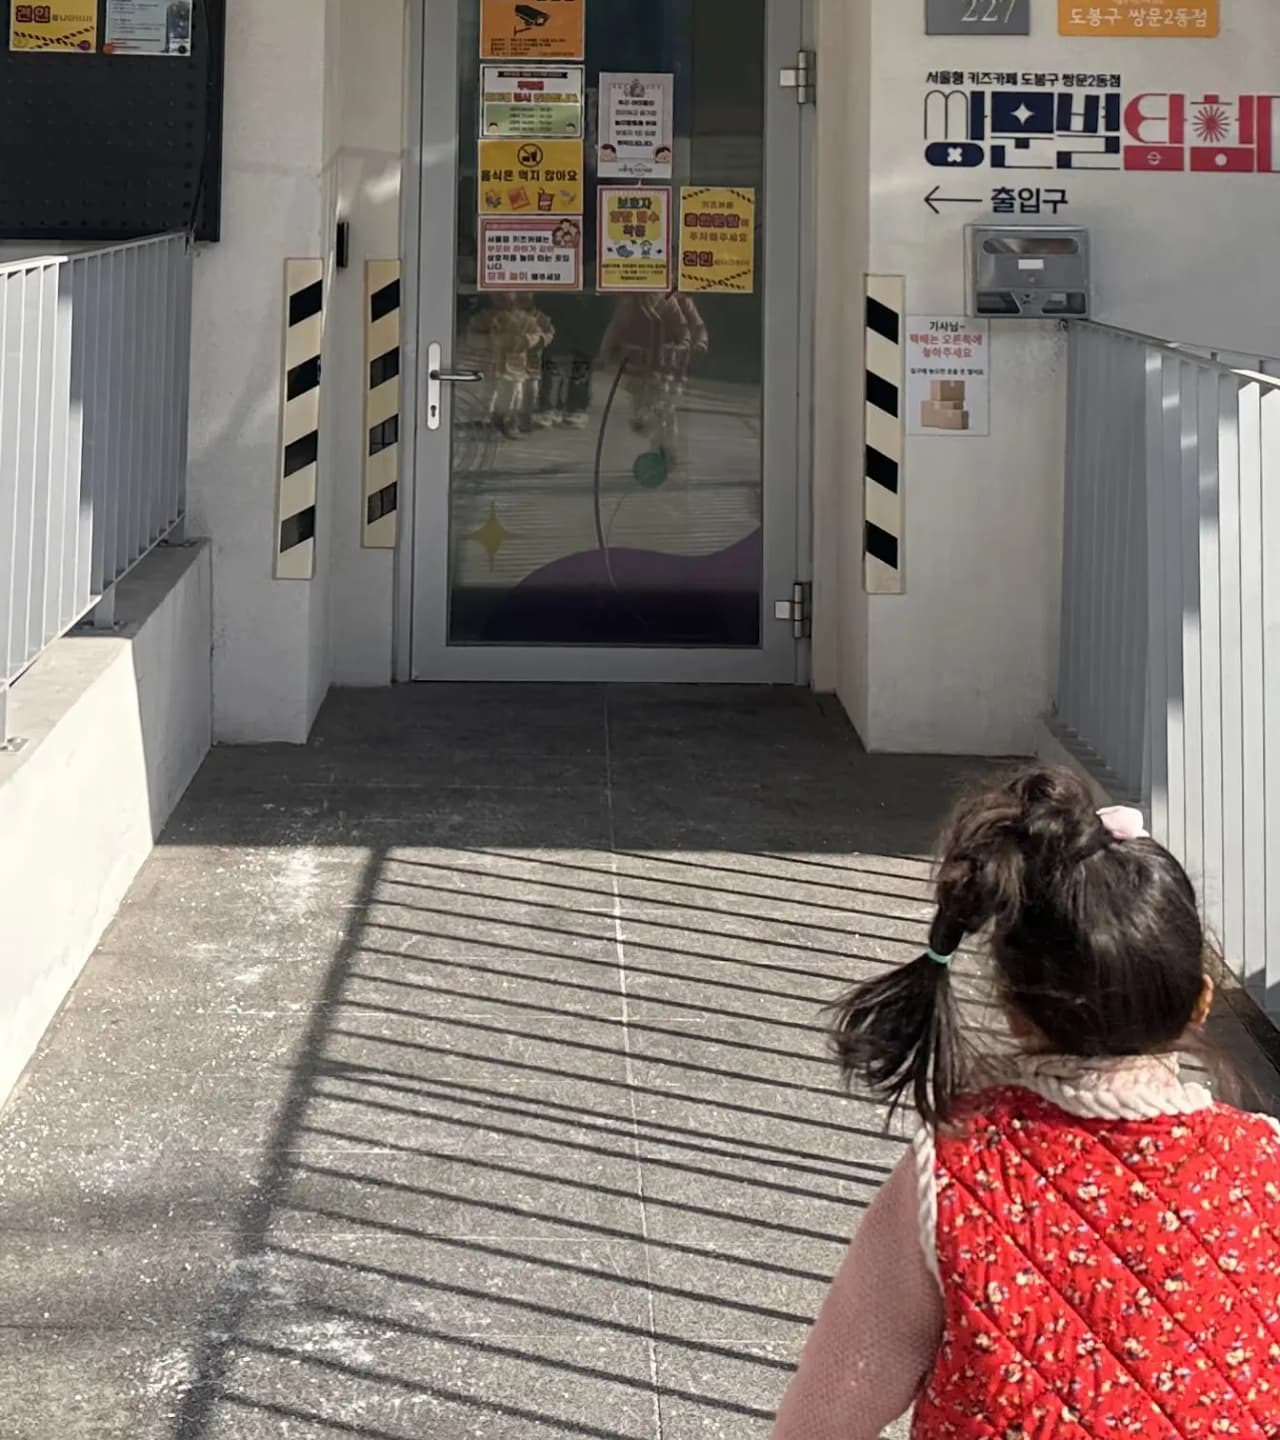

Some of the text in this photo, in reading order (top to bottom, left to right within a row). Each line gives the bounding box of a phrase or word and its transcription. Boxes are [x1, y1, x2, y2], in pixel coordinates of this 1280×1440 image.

[1069, 7, 1207, 28] 도봉구 쌍문2동점
[925, 70, 1120, 88] 서울형 키즈카페 도봉구 쌍문2동점
[518, 170, 540, 182] 먹지
[544, 169, 578, 182] 않아요
[990, 186, 1069, 214] 출입구
